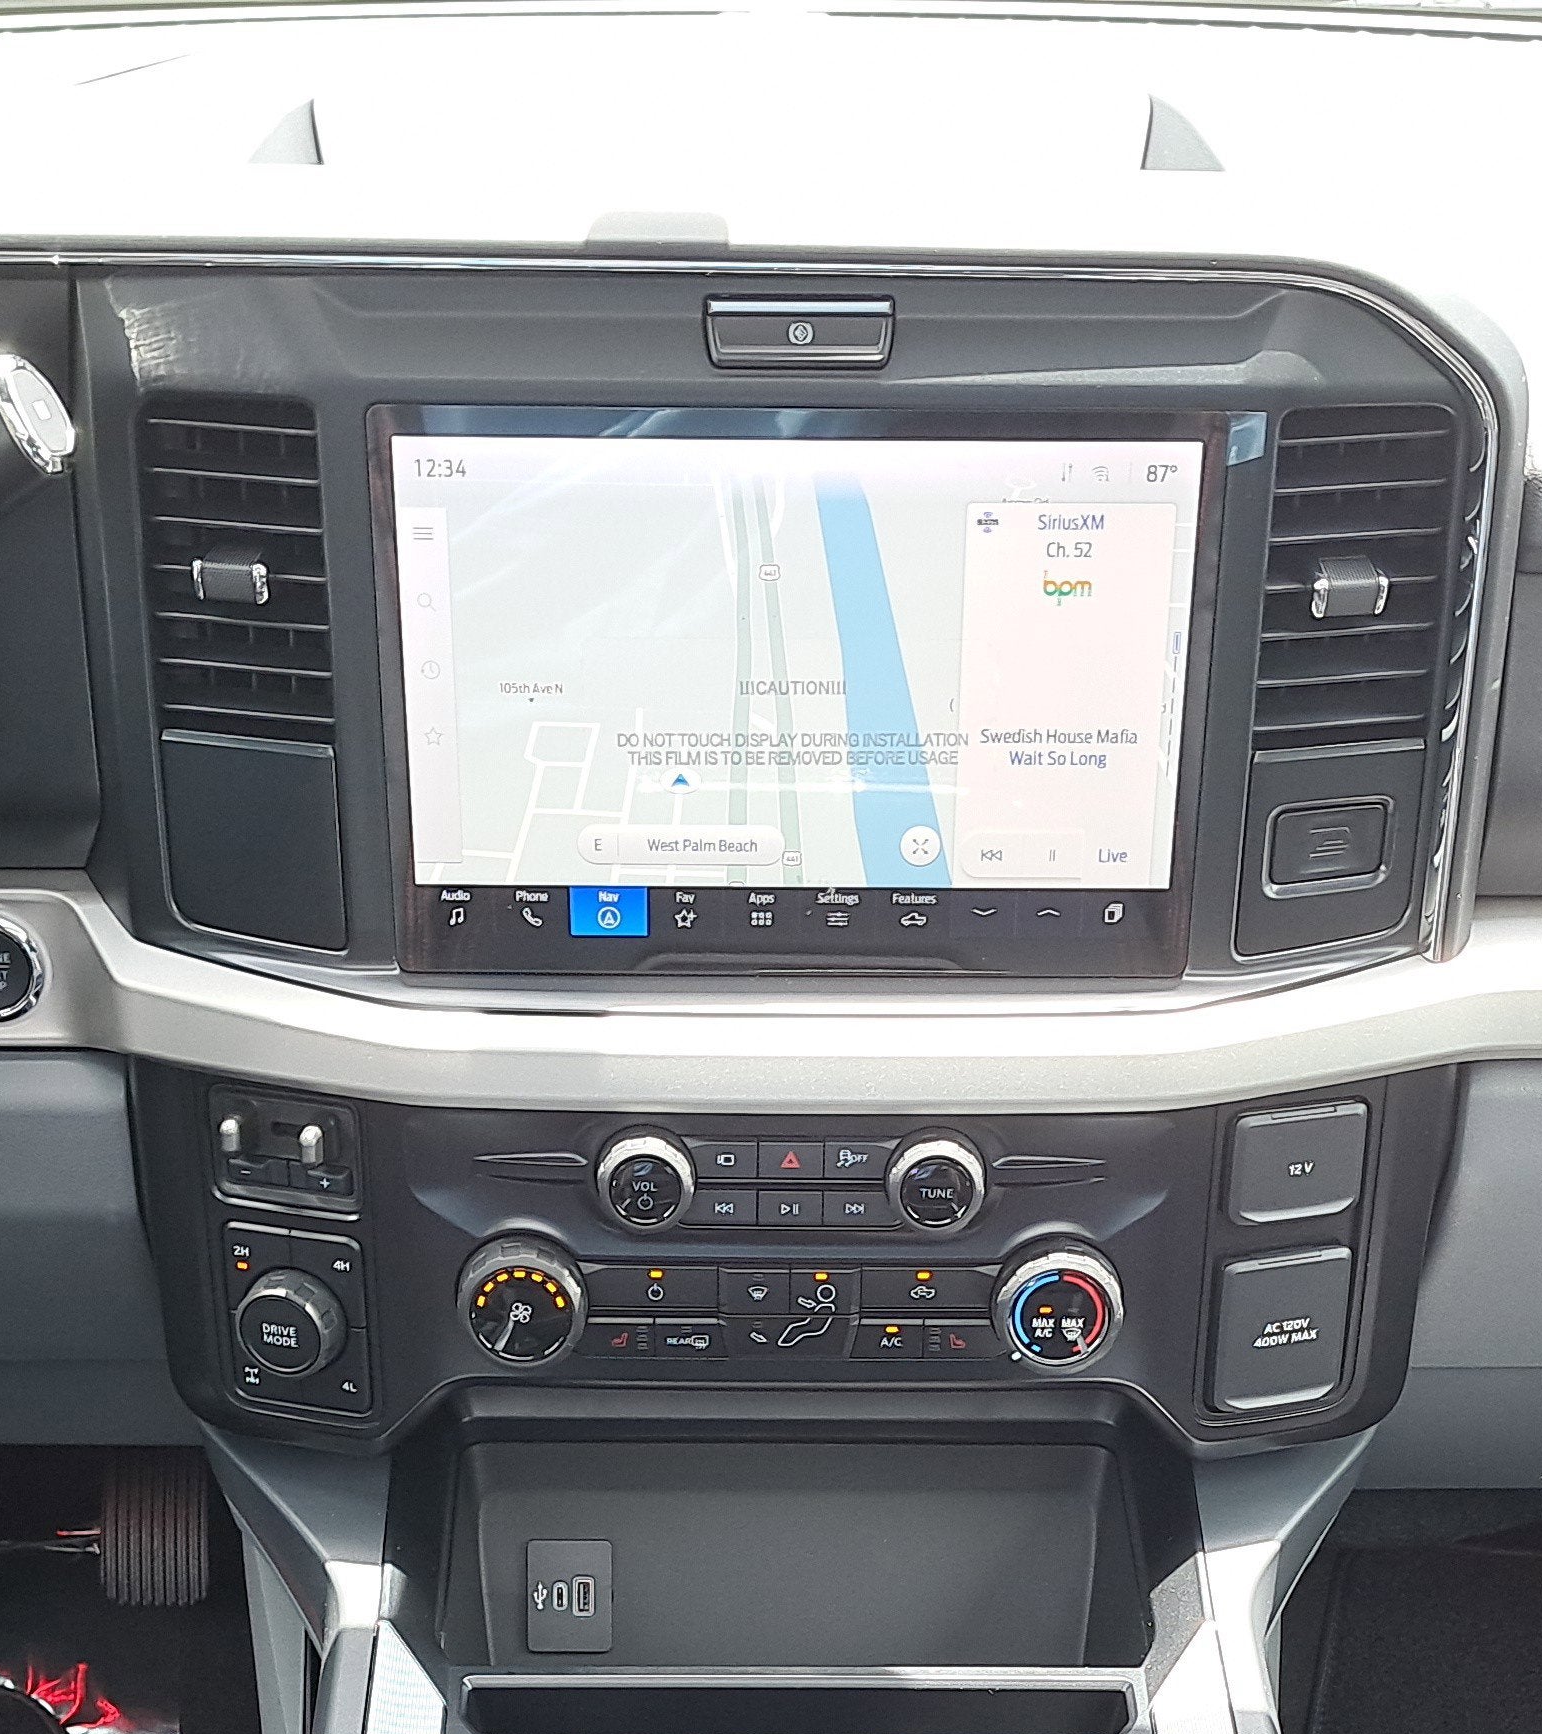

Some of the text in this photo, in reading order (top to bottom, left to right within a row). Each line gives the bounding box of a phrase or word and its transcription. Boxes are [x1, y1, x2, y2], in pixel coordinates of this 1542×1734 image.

[413, 458, 468, 479] 12:34
[1145, 464, 1178, 483] 87°
[1037, 513, 1105, 531] SiriusXM
[1046, 541, 1093, 559] Ch. 52
[1043, 571, 1093, 607] bpm
[498, 682, 564, 695] 105th Ave N
[617, 733, 969, 748] DO NOT TOUCH DISPLAY DURING INSTALLATION
[980, 728, 1138, 744] Swedish House Mafia
[628, 751, 958, 765] THIS FILM IS TO BE REMOVED BEFORE USAGE
[1009, 750, 1107, 769] Wait So Long
[594, 838, 602, 851] E
[647, 839, 758, 853] West Palm Beach
[1098, 848, 1128, 863] Live
[440, 889, 471, 902] Audio
[515, 890, 549, 902] Phone
[598, 890, 619, 902] Nav
[675, 892, 696, 903] Fav
[748, 892, 775, 906] Apps
[815, 891, 860, 906] Settings
[892, 892, 937, 904] Features
[851, 1151, 869, 1164] OFF
[1288, 1161, 1315, 1176] 12 V
[632, 1181, 659, 1193] VOL
[919, 1187, 954, 1200] TUNE
[233, 1245, 250, 1257] 2H
[332, 1260, 351, 1273] 4H
[1032, 1317, 1056, 1328] MAX
[1061, 1317, 1085, 1328] MAX
[1264, 1317, 1310, 1335] AC 120V
[262, 1322, 297, 1338] DRIVE
[263, 1333, 299, 1349] MODE
[666, 1336, 692, 1347] REAR
[880, 1336, 903, 1349] A/C
[1253, 1328, 1319, 1349] 400W MAX
[342, 1381, 358, 1393] 4L
